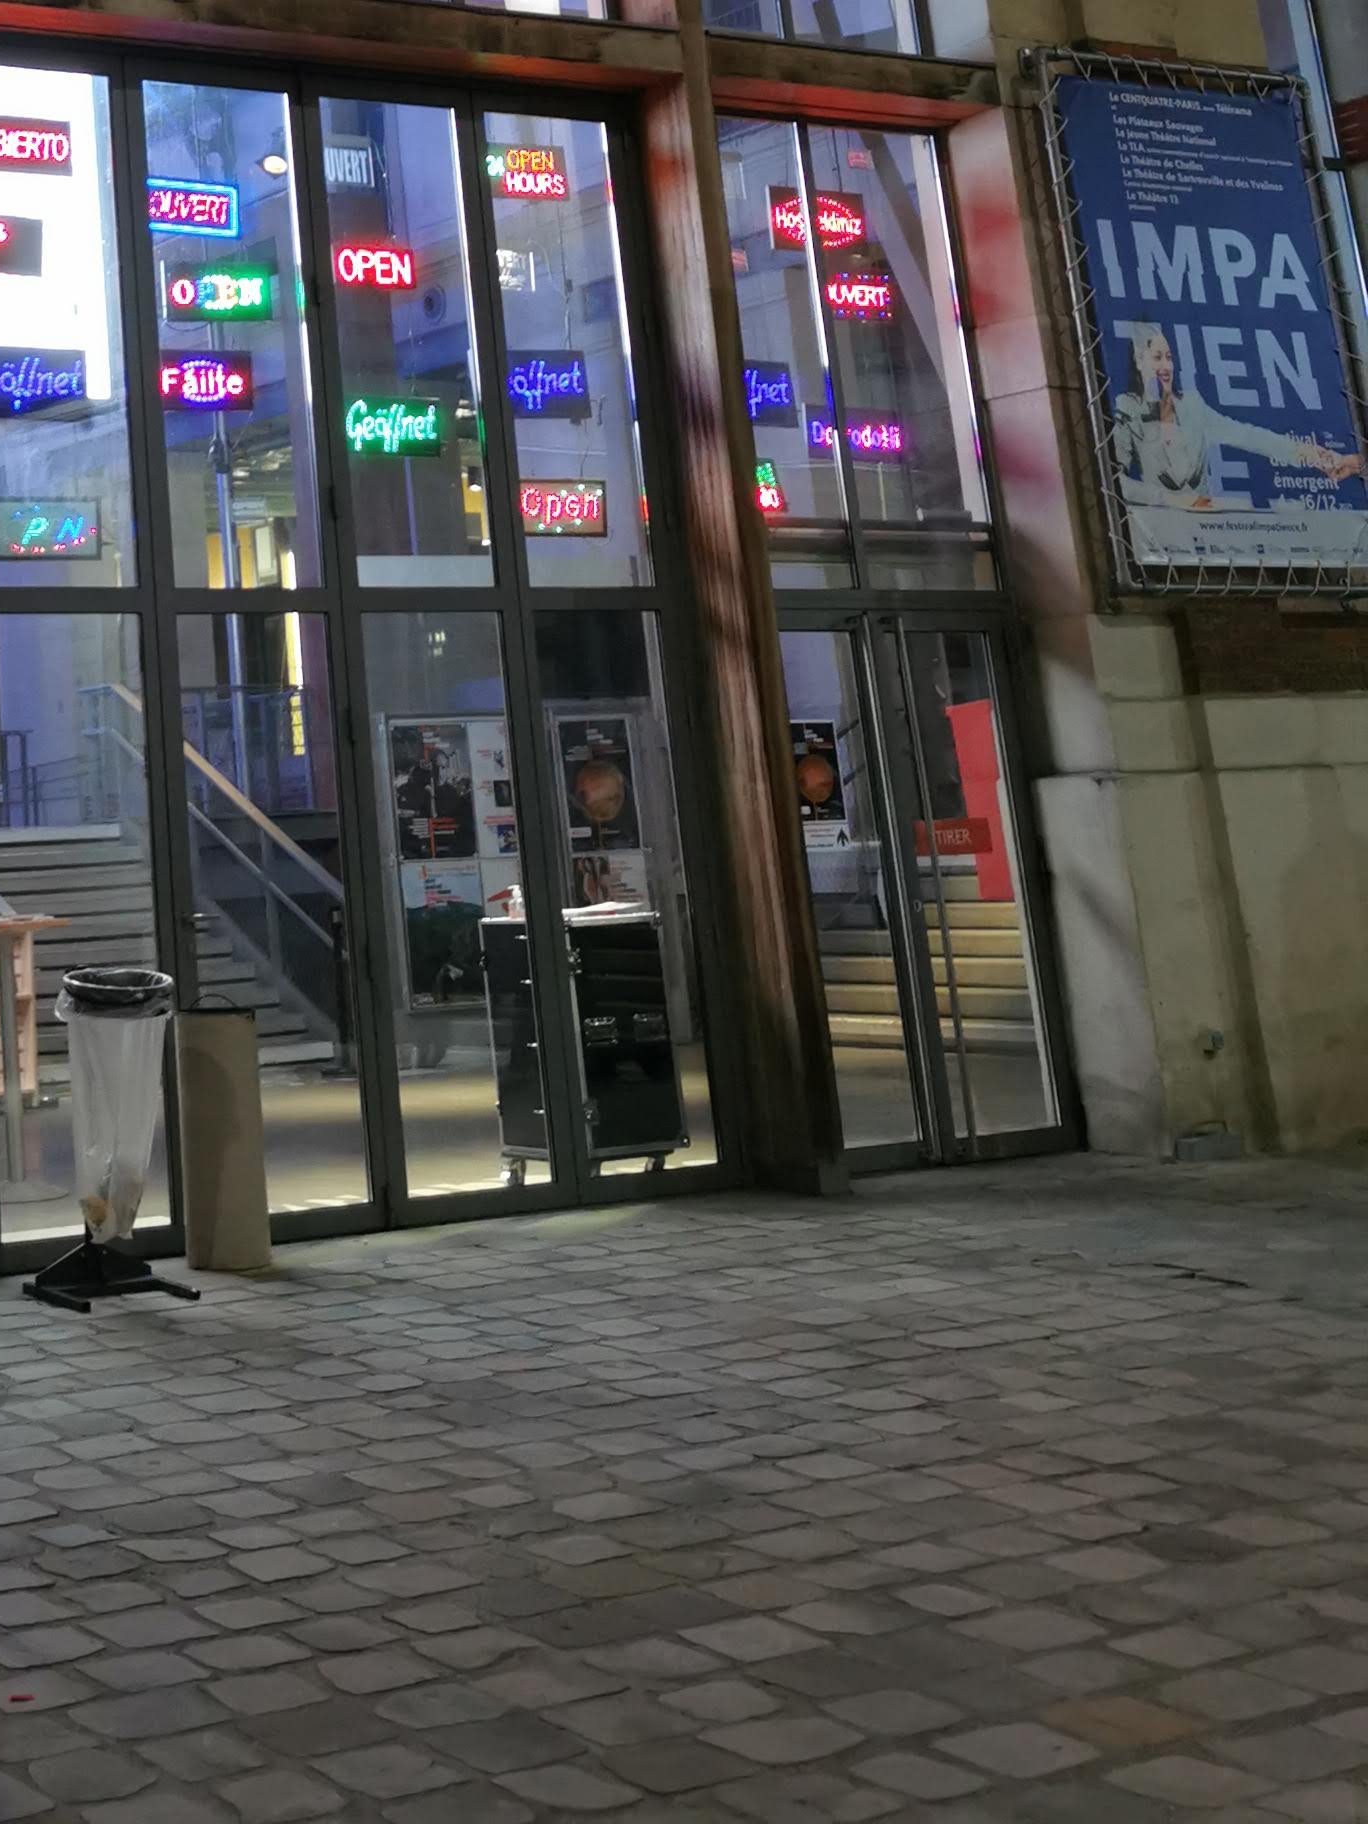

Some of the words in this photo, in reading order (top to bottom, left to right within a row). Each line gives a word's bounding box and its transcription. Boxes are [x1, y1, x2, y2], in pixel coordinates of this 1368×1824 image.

[506, 149, 554, 171] OPEN
[506, 171, 565, 195] HOURS
[150, 190, 228, 225] OUVERT
[338, 249, 412, 285] OPEN
[1096, 219, 1318, 312] IMPA
[172, 275, 262, 310] OPEN
[162, 364, 244, 399] Fáilte
[346, 400, 438, 452] Geöffnet
[1273, 472, 1340, 493] émergent
[521, 488, 599, 523] Open
[934, 829, 972, 847] TIRER
